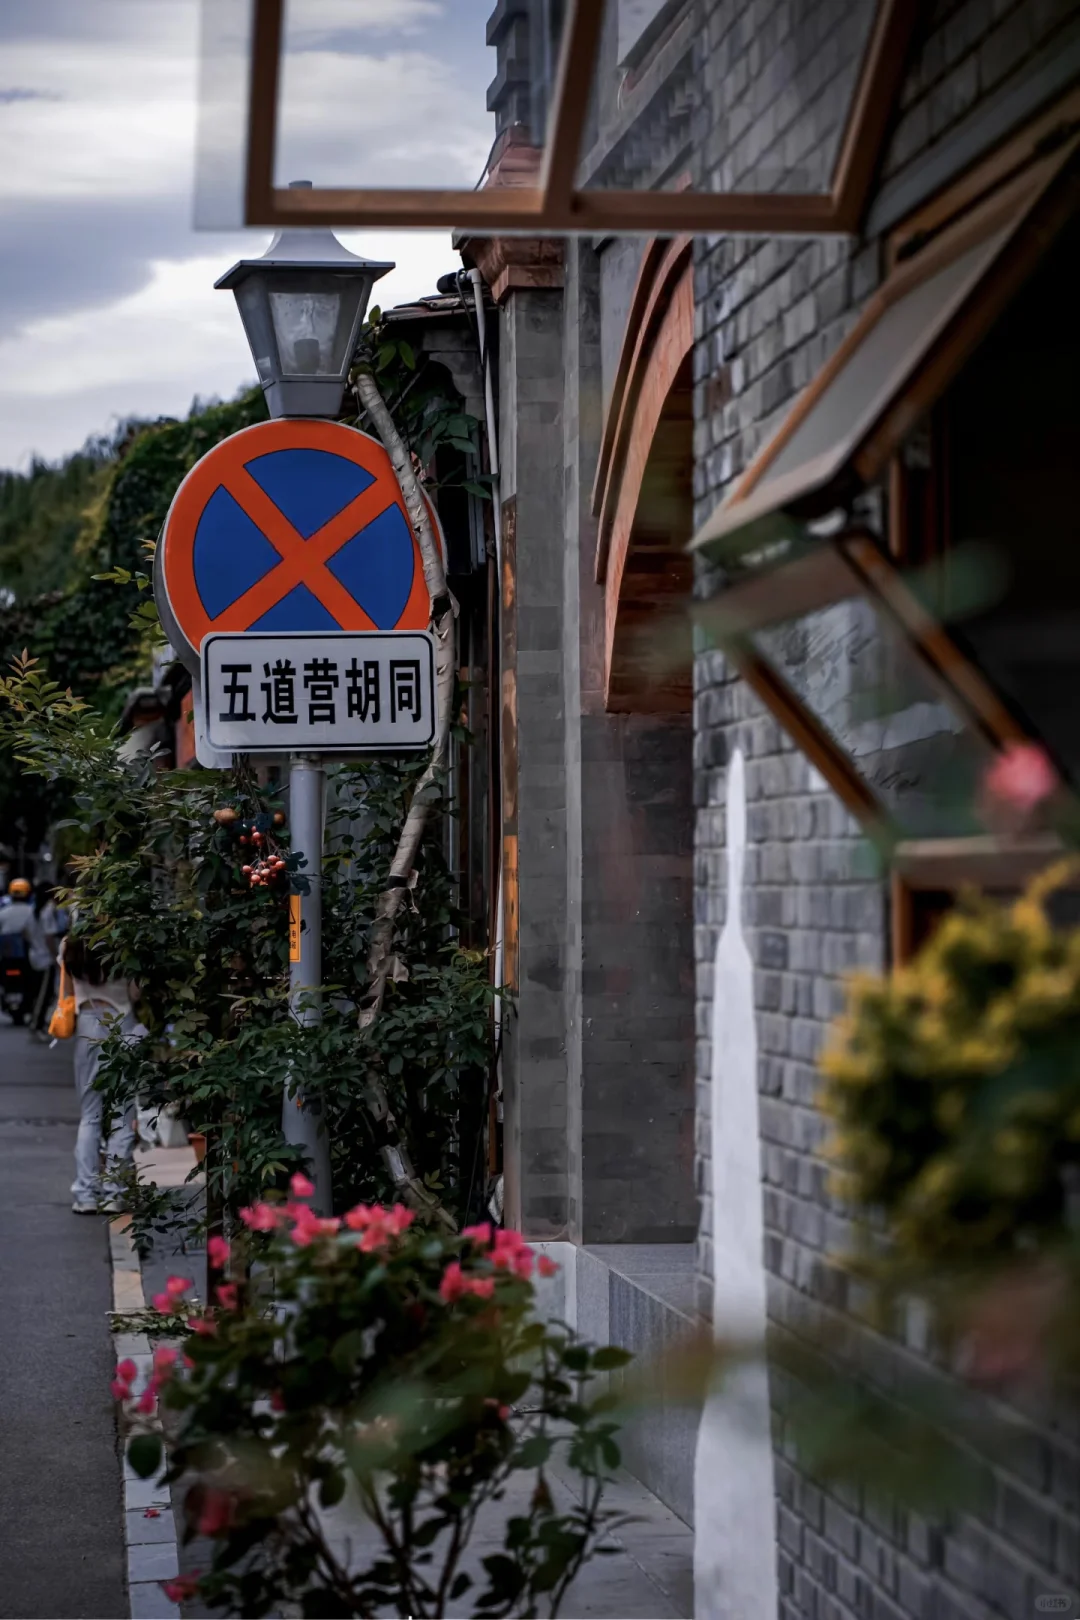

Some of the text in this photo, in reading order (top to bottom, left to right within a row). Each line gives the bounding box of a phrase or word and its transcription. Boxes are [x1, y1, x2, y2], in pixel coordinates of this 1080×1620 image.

[219, 658, 422, 725] 五道营胡同
